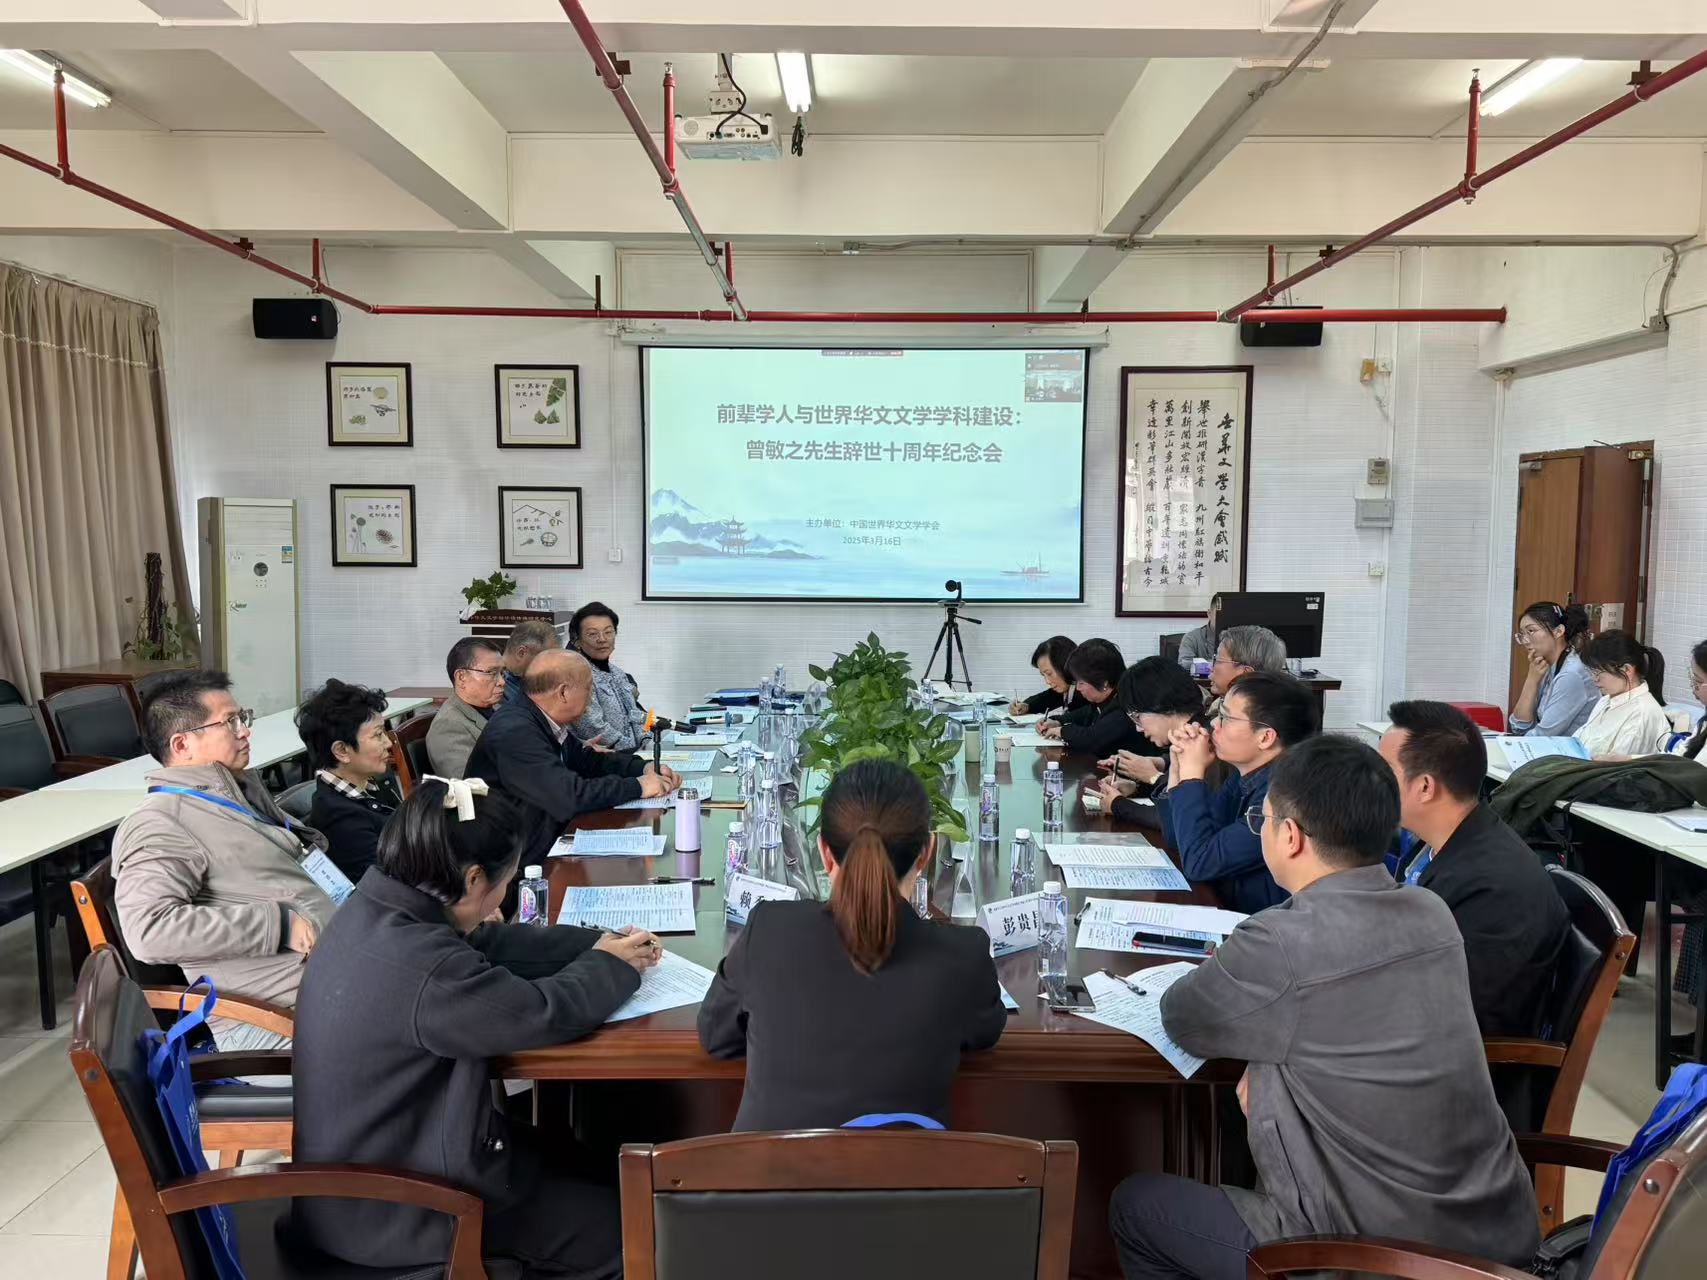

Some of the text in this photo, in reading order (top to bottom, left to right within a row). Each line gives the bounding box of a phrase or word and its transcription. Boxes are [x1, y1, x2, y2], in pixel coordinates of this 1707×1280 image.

[716, 403, 1023, 428] 前辈学人与世界华文文学学科建设：
[745, 439, 1003, 464] 曾敏之先生辞世十周年纪念会
[841, 536, 901, 547] 2025年3月16日
